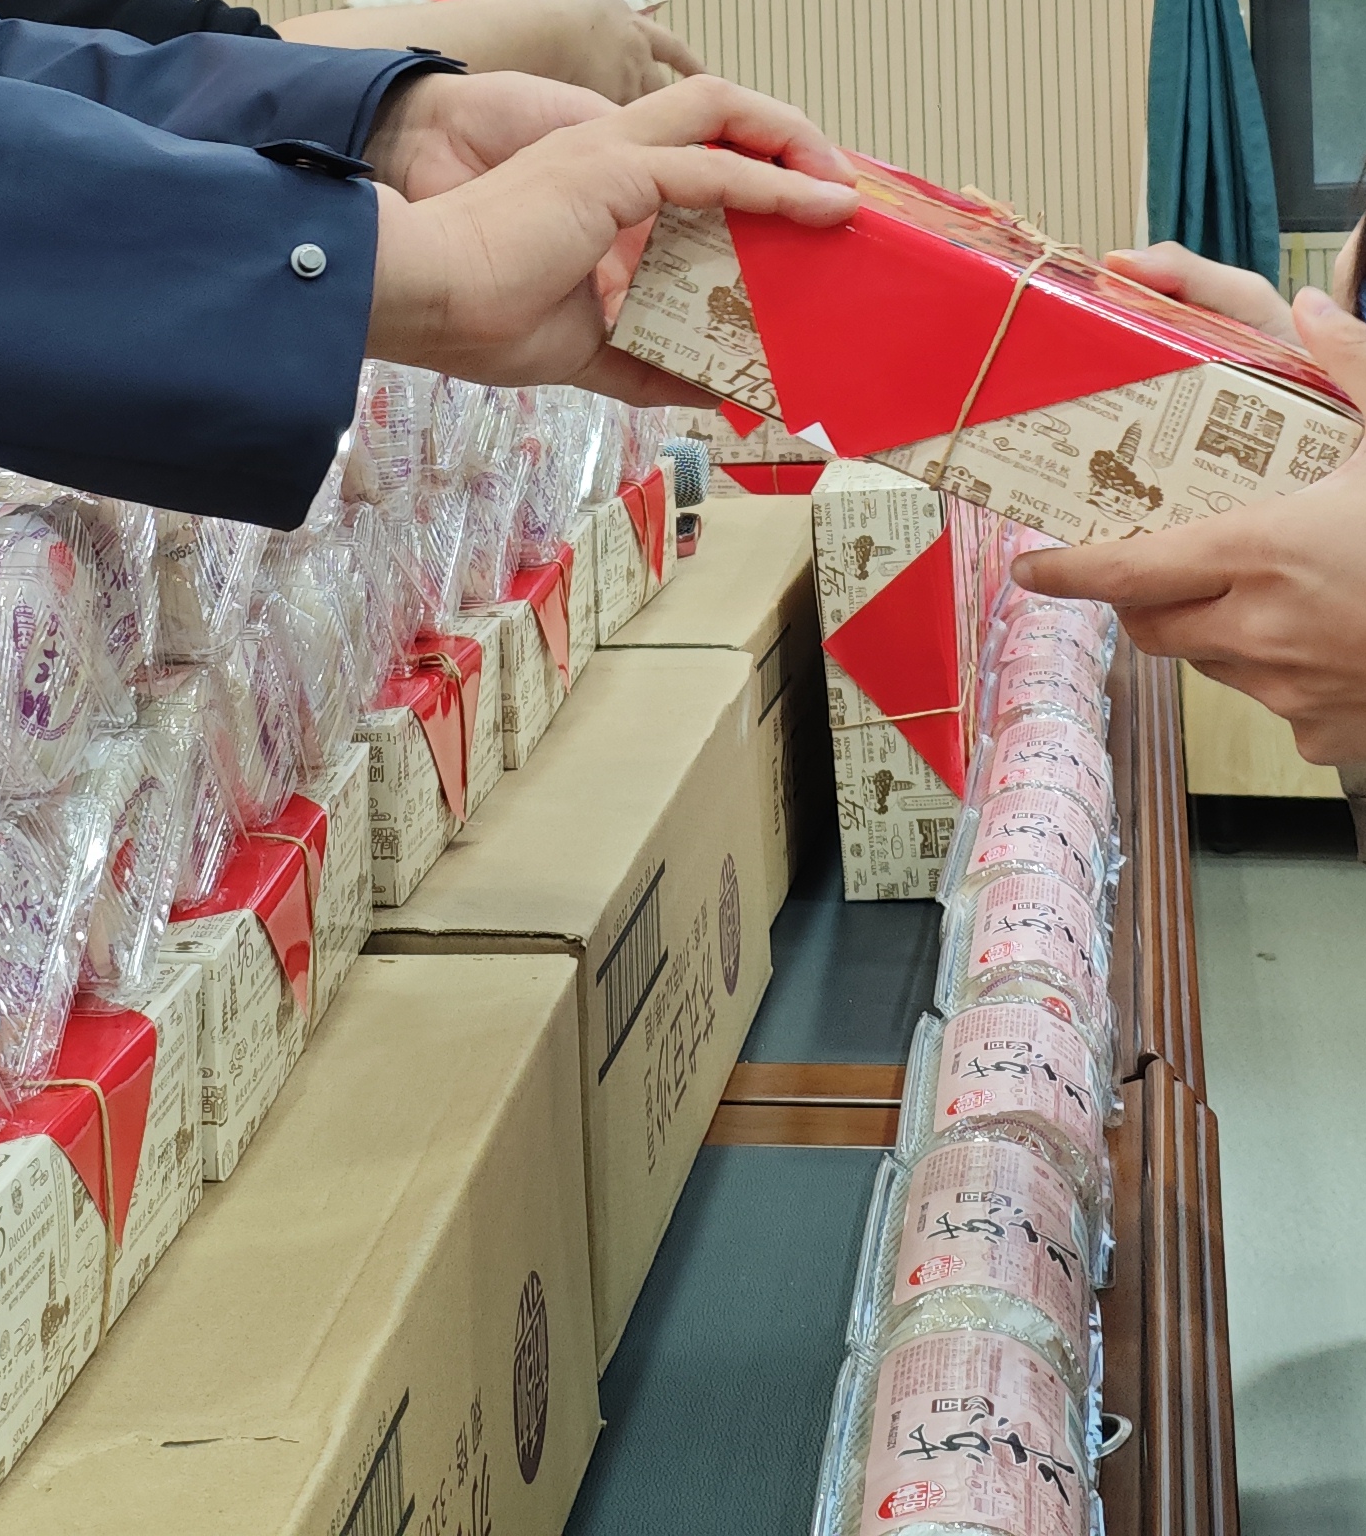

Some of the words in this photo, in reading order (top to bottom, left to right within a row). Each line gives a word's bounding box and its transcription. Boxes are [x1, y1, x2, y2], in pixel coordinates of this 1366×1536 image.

[632, 324, 673, 351] SINCE
[674, 342, 701, 362] 1773
[1304, 419, 1348, 445] SINCE
[1296, 433, 1343, 468] 乾隆
[1191, 456, 1230, 480] SINCE
[1232, 472, 1258, 491] 1773
[823, 502, 832, 527] SINCE
[1009, 488, 1052, 513] SINCE
[1053, 506, 1083, 529] 1773
[826, 528, 834, 546] 1773
[842, 736, 852, 759] SINCE
[845, 762, 853, 779] 1773
[866, 819, 878, 877] DAOXIANGCUN
[874, 819, 892, 876] 稻香金牌
[655, 940, 716, 1147] 苏式豆沙
[8, 1190, 53, 1252] DAOXIANGCUN
